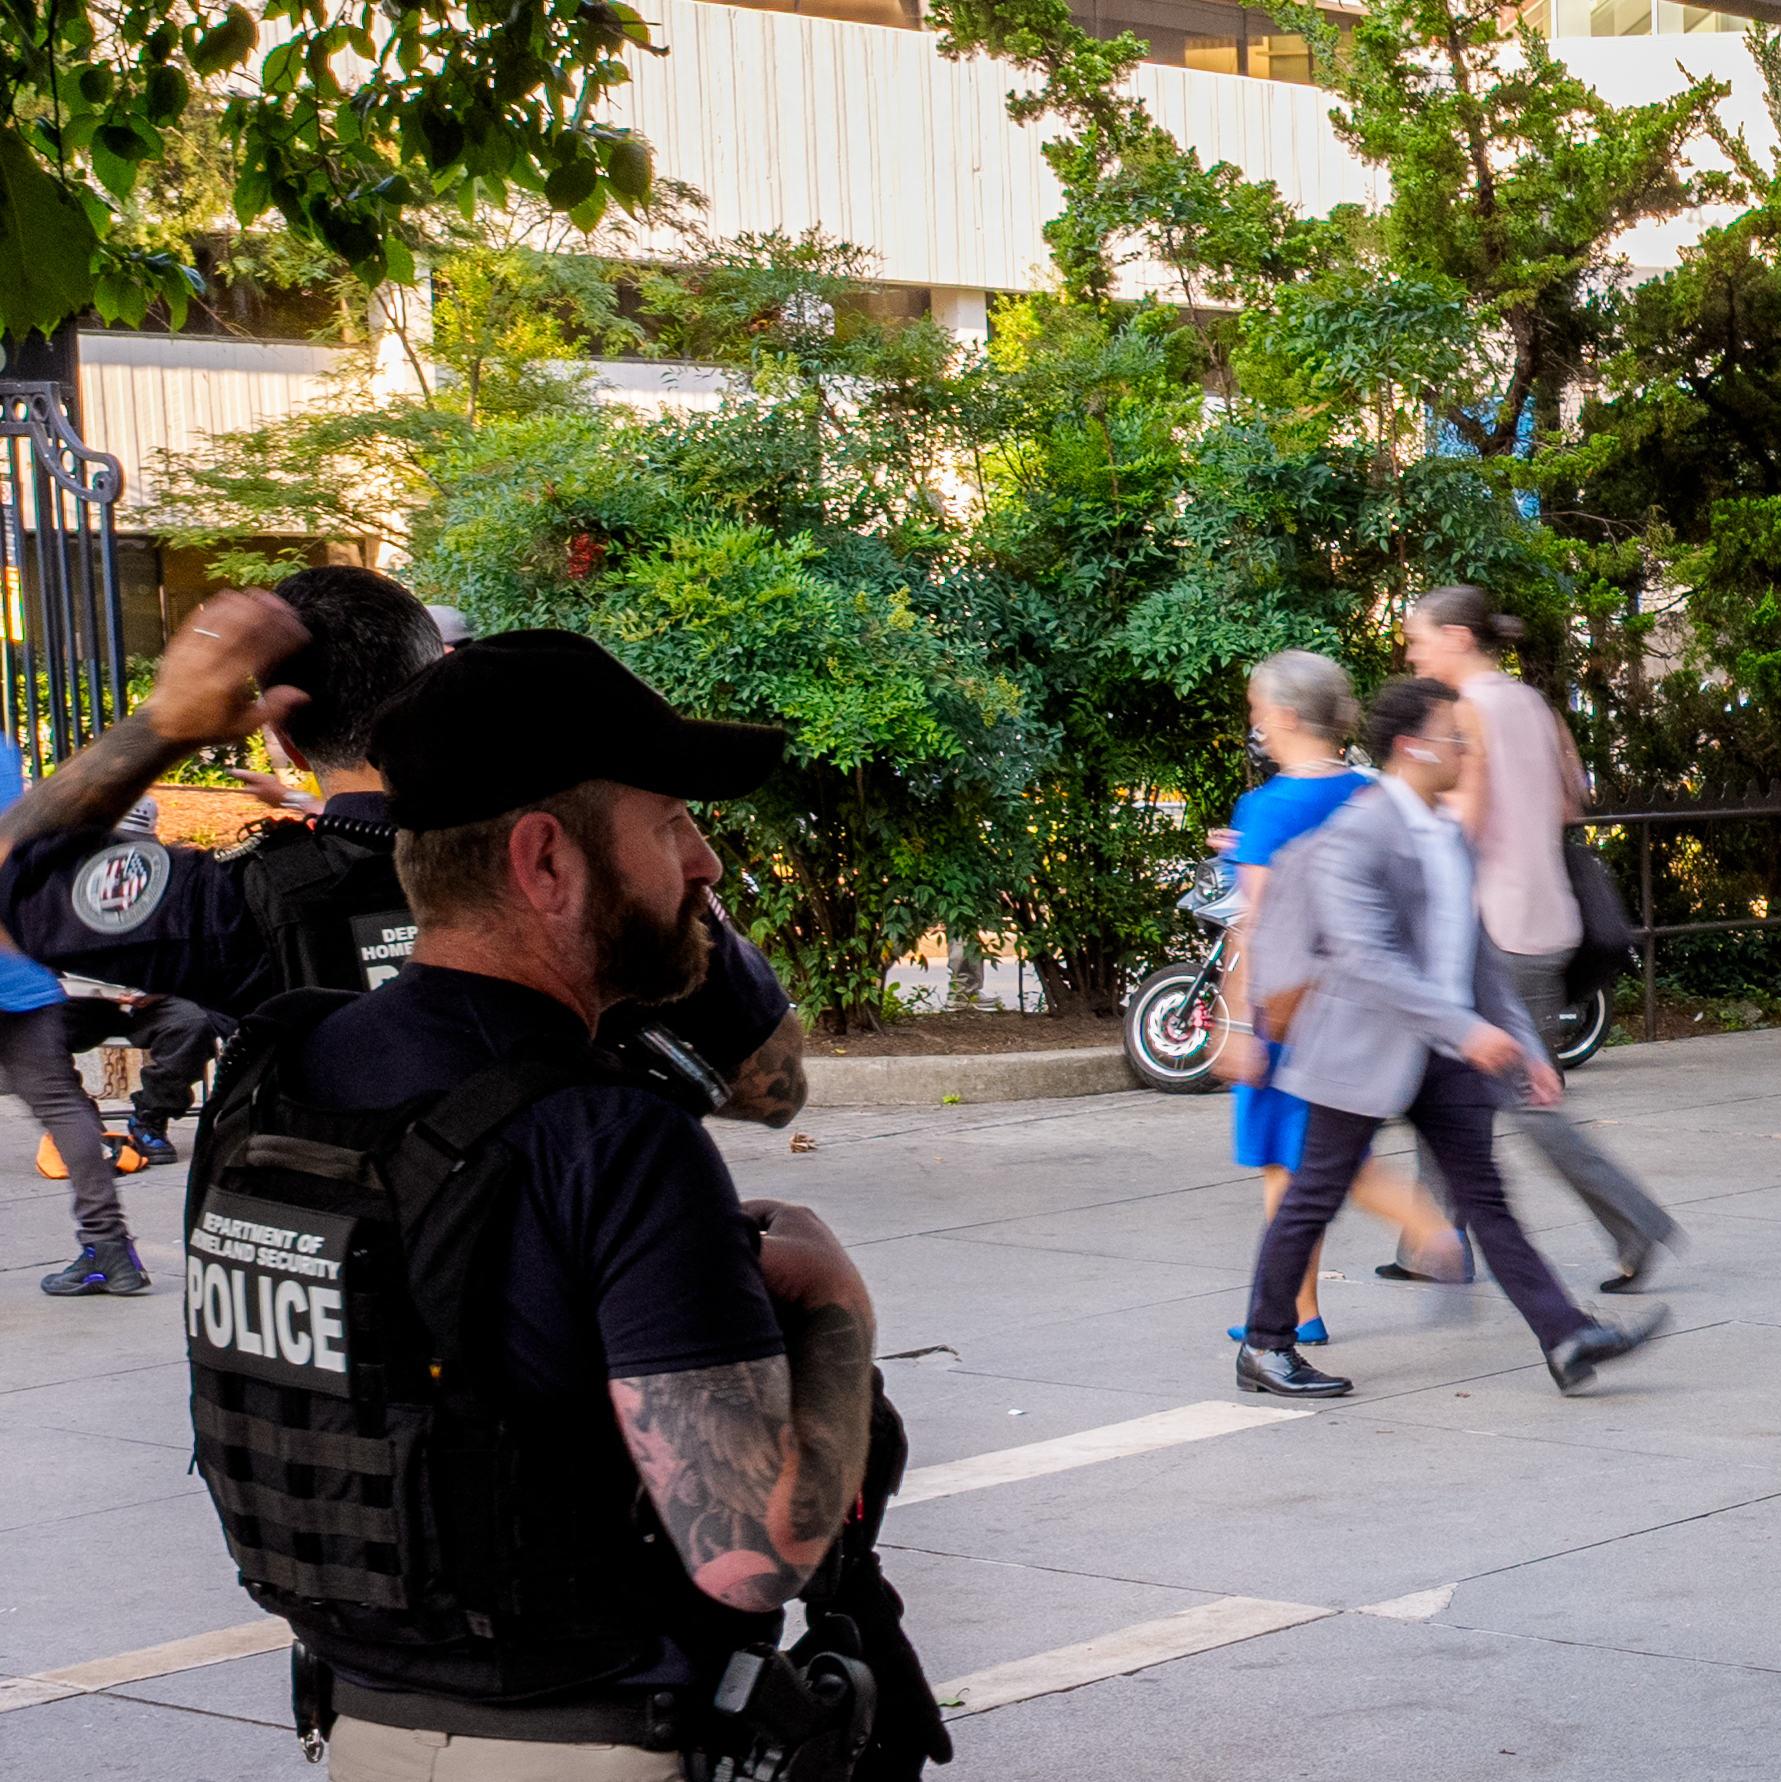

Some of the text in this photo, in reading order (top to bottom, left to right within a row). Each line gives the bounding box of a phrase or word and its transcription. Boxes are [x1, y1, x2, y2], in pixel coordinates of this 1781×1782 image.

[360, 941, 414, 961] HOME
[381, 925, 418, 943] DEP
[189, 1228, 343, 1280] MELAND SECURITY
[202, 1212, 326, 1254] EPARTMENT OF
[188, 1255, 347, 1373] POLICE
